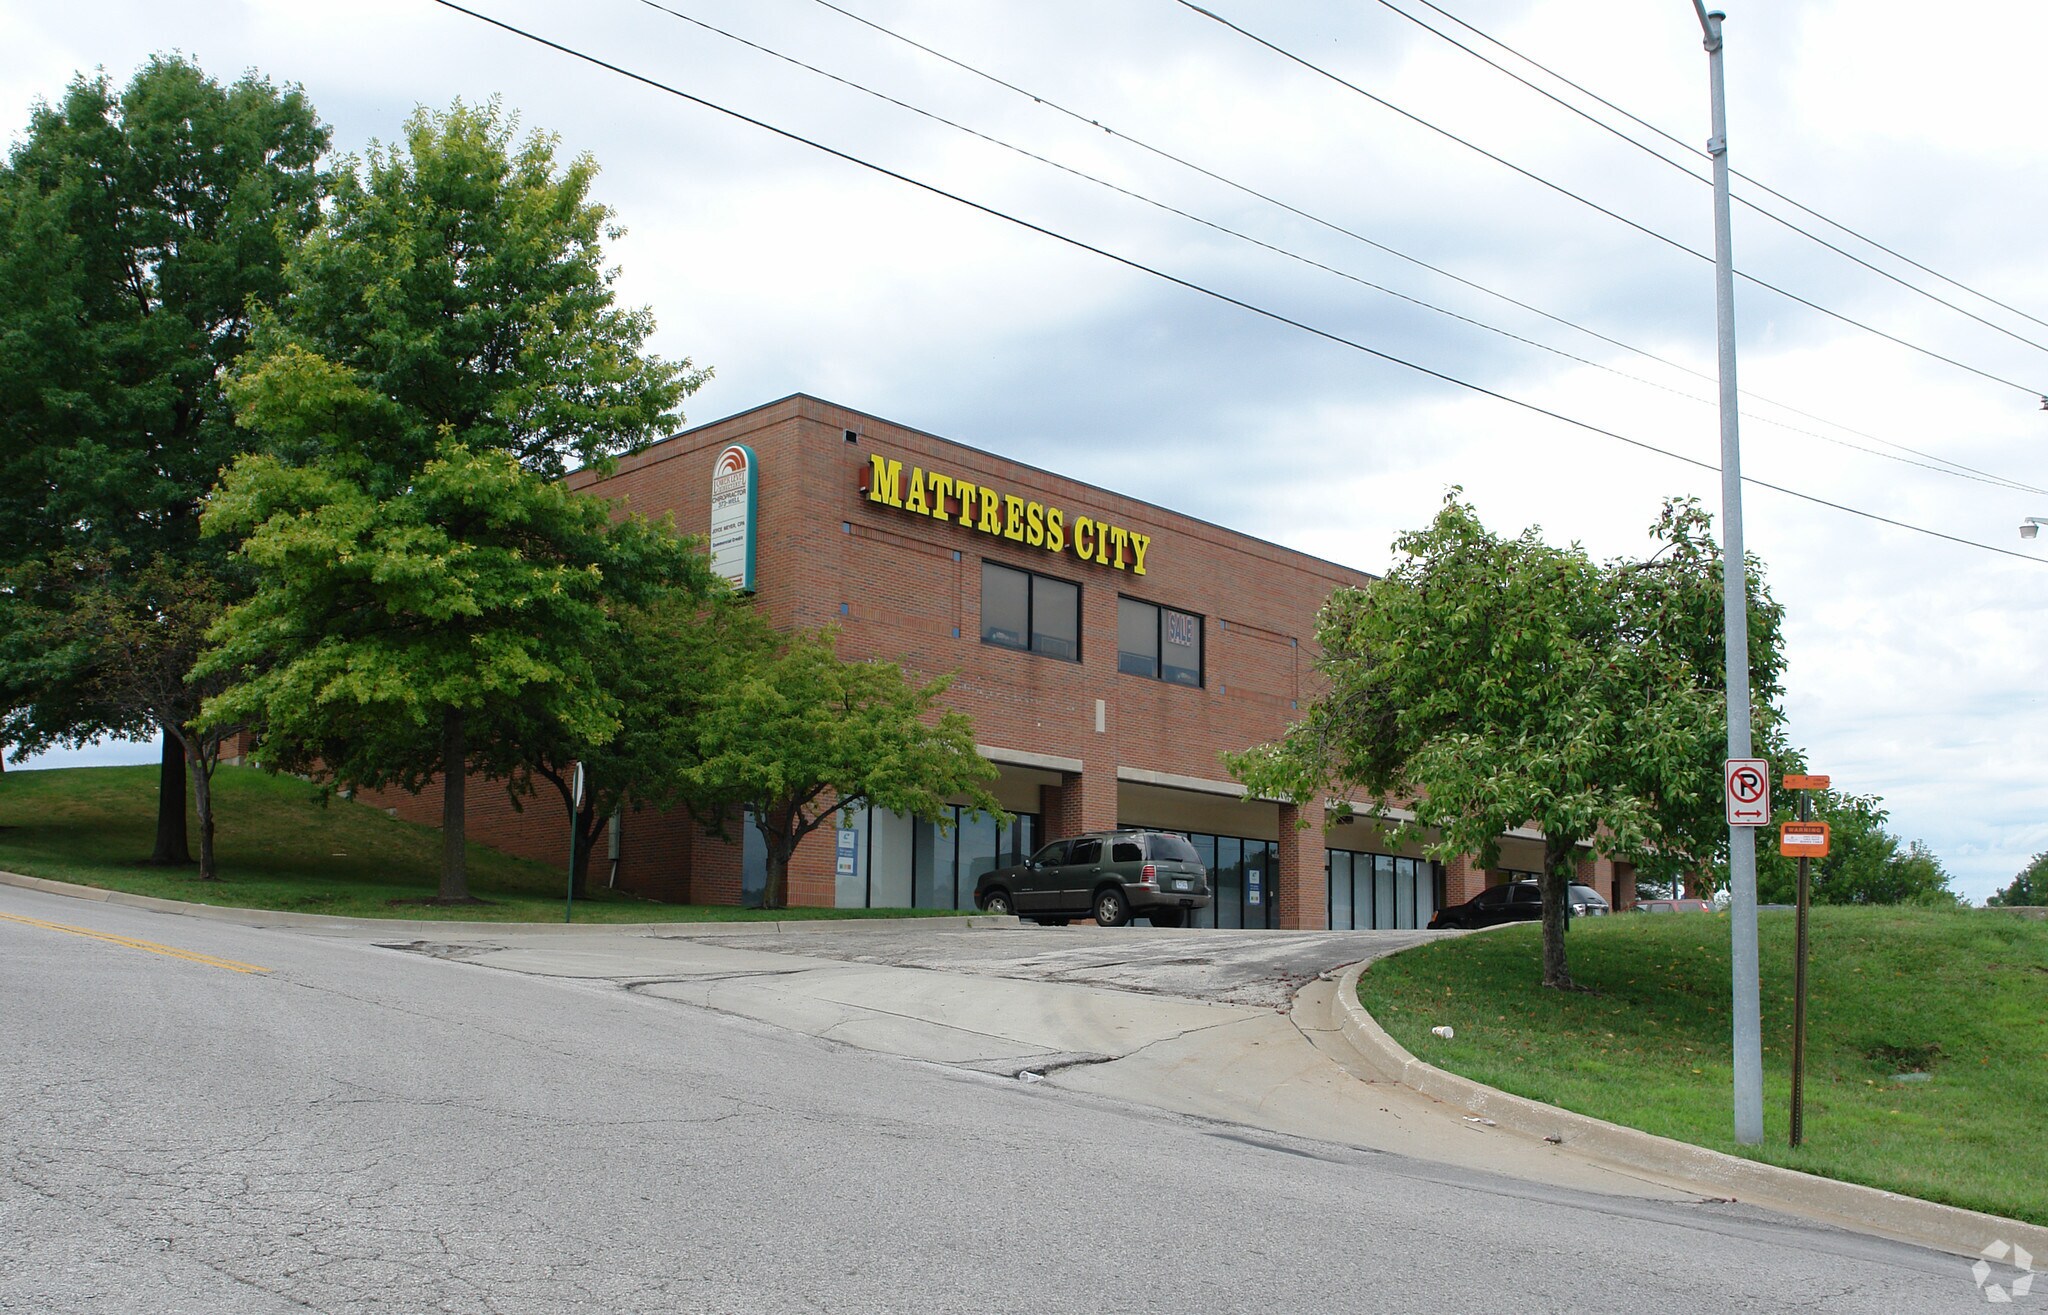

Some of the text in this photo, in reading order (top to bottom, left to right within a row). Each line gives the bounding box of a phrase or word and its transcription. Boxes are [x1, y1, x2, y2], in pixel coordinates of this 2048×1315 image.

[712, 489, 746, 503] CHIROPRACTOR
[870, 453, 1150, 576] MATTRESS CITY
[1170, 614, 1193, 642] SALE
[1740, 773, 1758, 796] P
